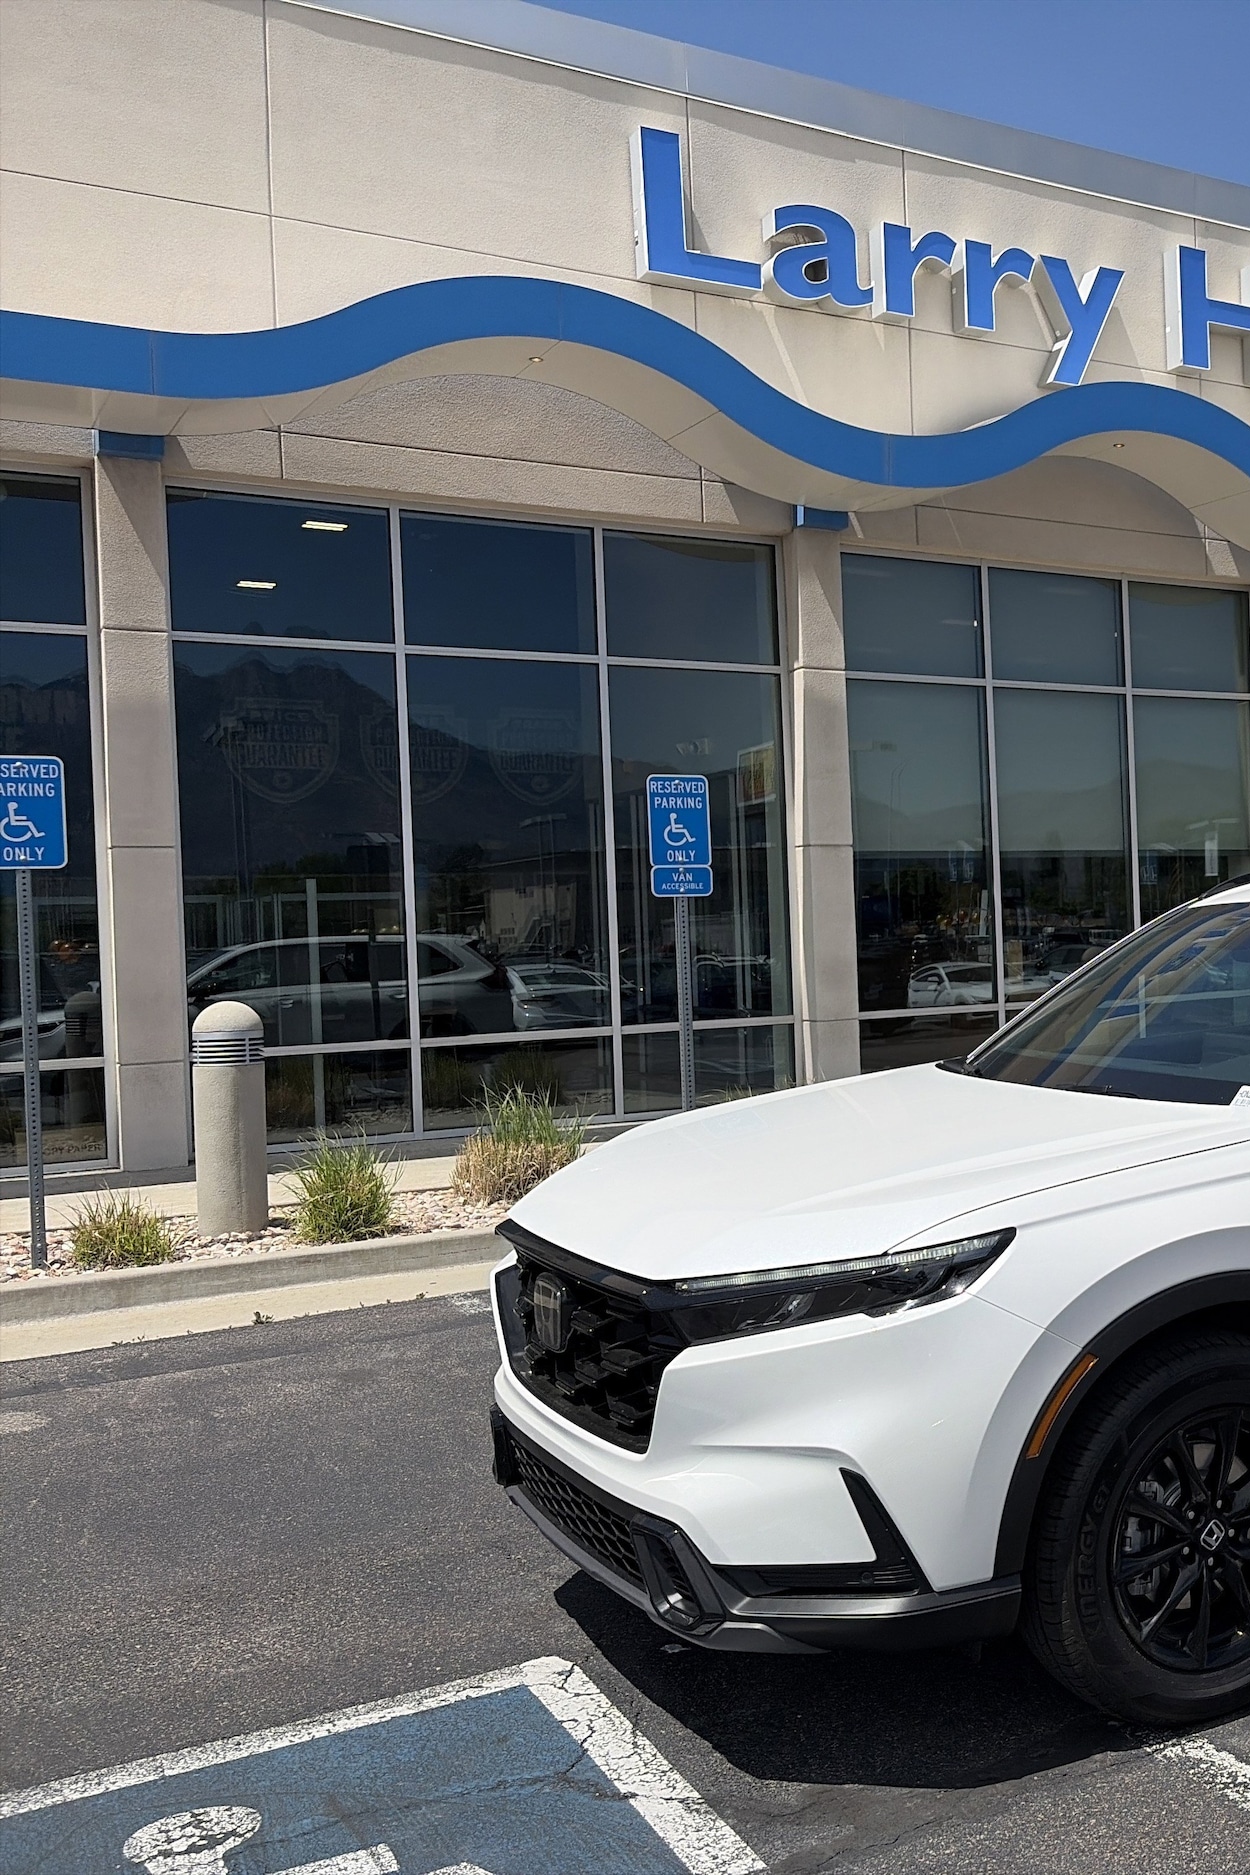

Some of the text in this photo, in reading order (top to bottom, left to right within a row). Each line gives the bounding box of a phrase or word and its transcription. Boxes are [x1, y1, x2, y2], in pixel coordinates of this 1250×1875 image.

[634, 126, 1125, 387] Larry
[0, 763, 59, 778] SERVED
[0, 782, 55, 797] ARKING
[650, 780, 705, 793] RESERVED
[654, 797, 703, 809] PARKING
[3, 846, 45, 861] ONLY
[666, 849, 696, 862] ONLY
[672, 872, 693, 882] VAN
[661, 882, 704, 890] ACCESSIBLE
